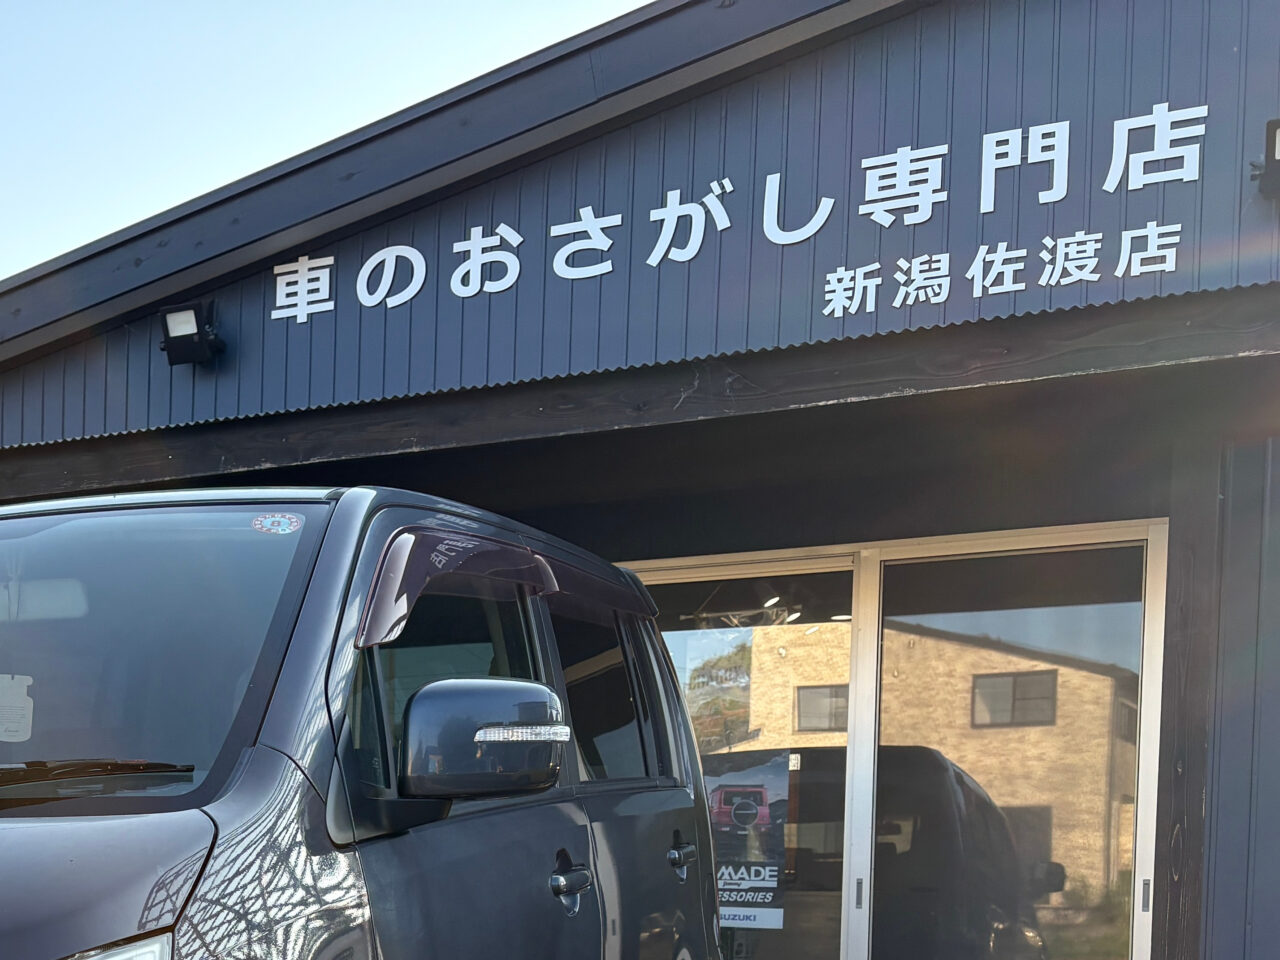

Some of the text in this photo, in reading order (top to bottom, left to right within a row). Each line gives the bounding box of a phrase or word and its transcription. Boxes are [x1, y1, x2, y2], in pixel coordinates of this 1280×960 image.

[271, 102, 1208, 323] 車のおさがし専門店
[822, 221, 1181, 318] 新潟佐渡店
